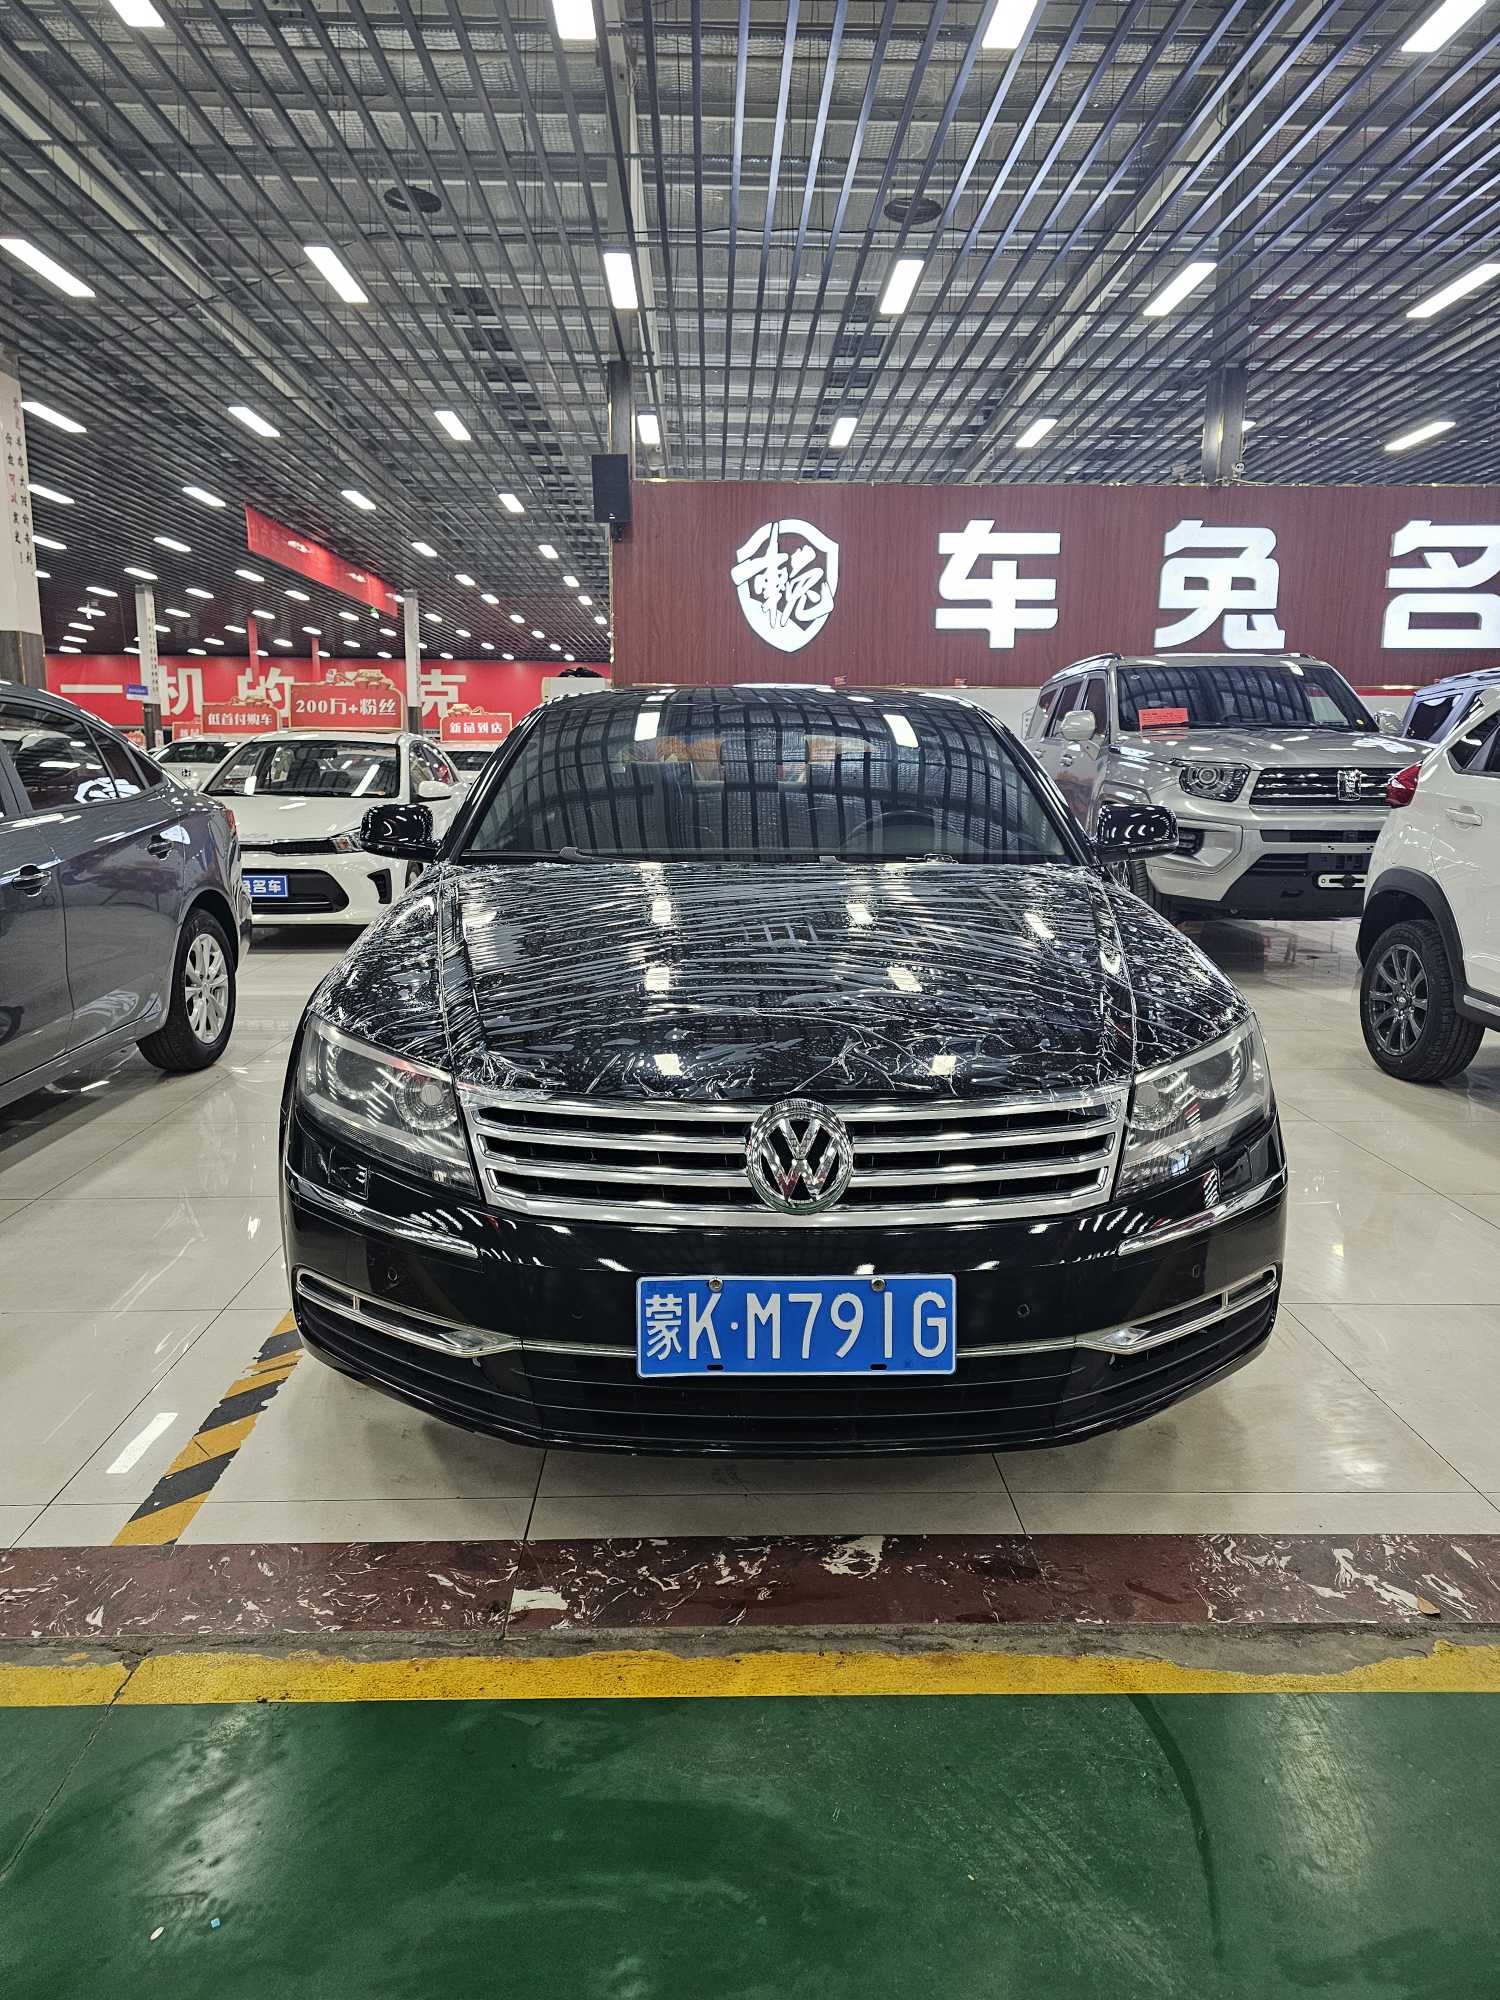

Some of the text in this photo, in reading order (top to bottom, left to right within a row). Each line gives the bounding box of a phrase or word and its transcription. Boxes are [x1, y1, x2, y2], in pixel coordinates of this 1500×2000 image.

[295, 697, 398, 716] 200万+粉丝
[208, 712, 272, 726] 低首付购车
[449, 721, 503, 734] 新品到店
